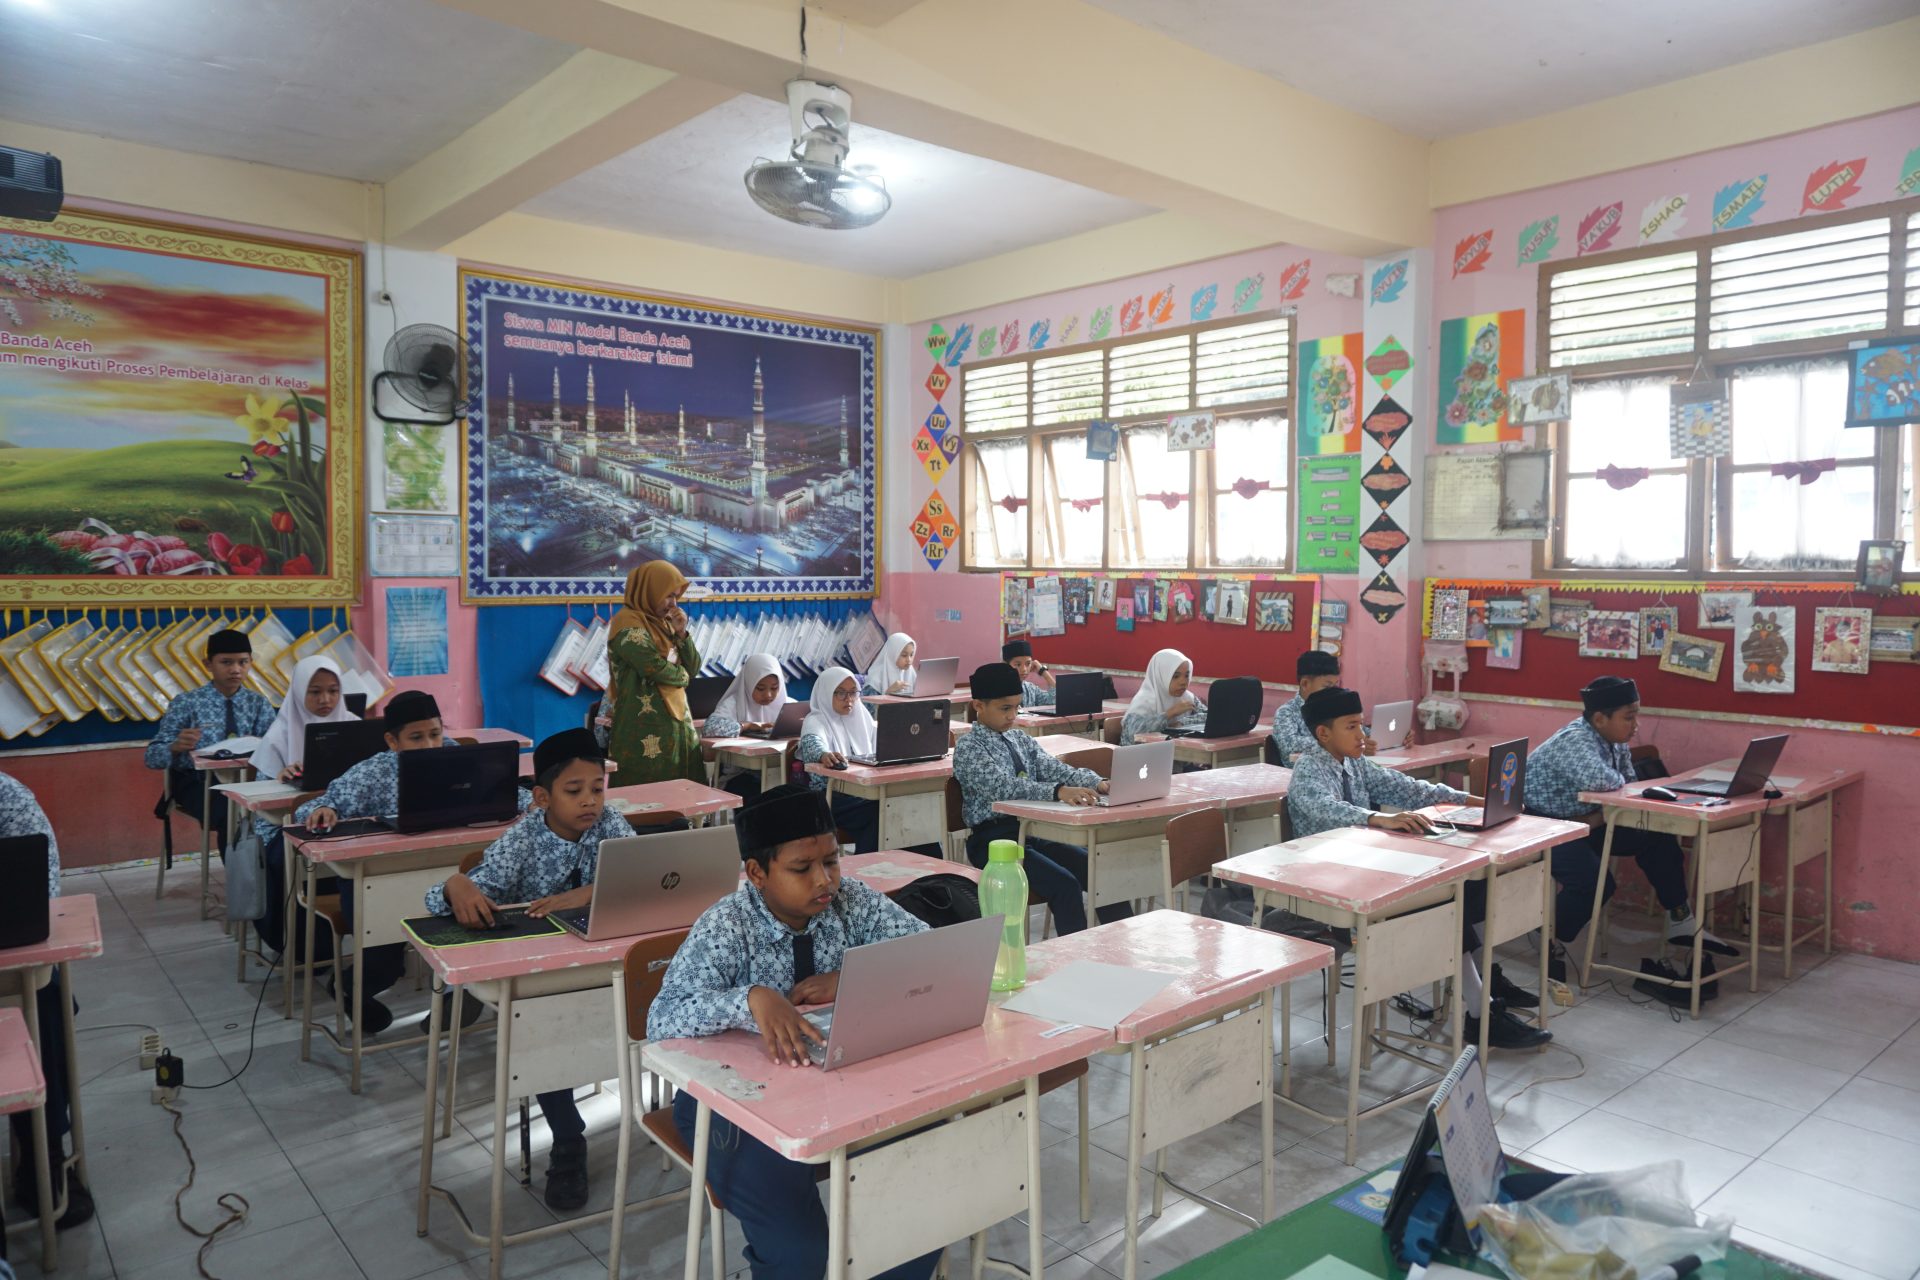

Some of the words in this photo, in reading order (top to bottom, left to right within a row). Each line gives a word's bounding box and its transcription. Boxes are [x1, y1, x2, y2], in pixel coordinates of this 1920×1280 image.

[1811, 167, 1855, 205] LUTH
[1713, 177, 1765, 228] ISMAIL
[1580, 207, 1619, 248] YA'KUB
[1641, 196, 1686, 239] ISHAQ
[1520, 218, 1553, 259] YUSUF
[1455, 236, 1489, 270] AYYUB
[504, 312, 544, 331] Siswa
[547, 317, 573, 335] MIN
[575, 322, 615, 339] Model
[618, 328, 657, 345] Banda
[659, 332, 691, 349] Aceh
[0, 331, 49, 349] Banda
[54, 337, 93, 352] Aceh
[504, 335, 574, 356] semuanya
[576, 340, 654, 362] berkarakter
[656, 350, 693, 367] islami
[928, 335, 946, 349] Ww
[23, 354, 101, 371] mengikuti
[107, 360, 154, 376] Proses
[159, 365, 254, 384] Pembelajaran
[258, 374, 271, 386] di
[275, 376, 309, 389] Kelas
[931, 375, 945, 388] Vv
[931, 415, 946, 429] Uu
[916, 439, 930, 451] Xx
[929, 459, 942, 472] Tt
[929, 500, 943, 516] Ss
[916, 522, 928, 537] Zz
[942, 525, 954, 537] Rr
[928, 543, 944, 559] Rr
[660, 871, 681, 890] hp
